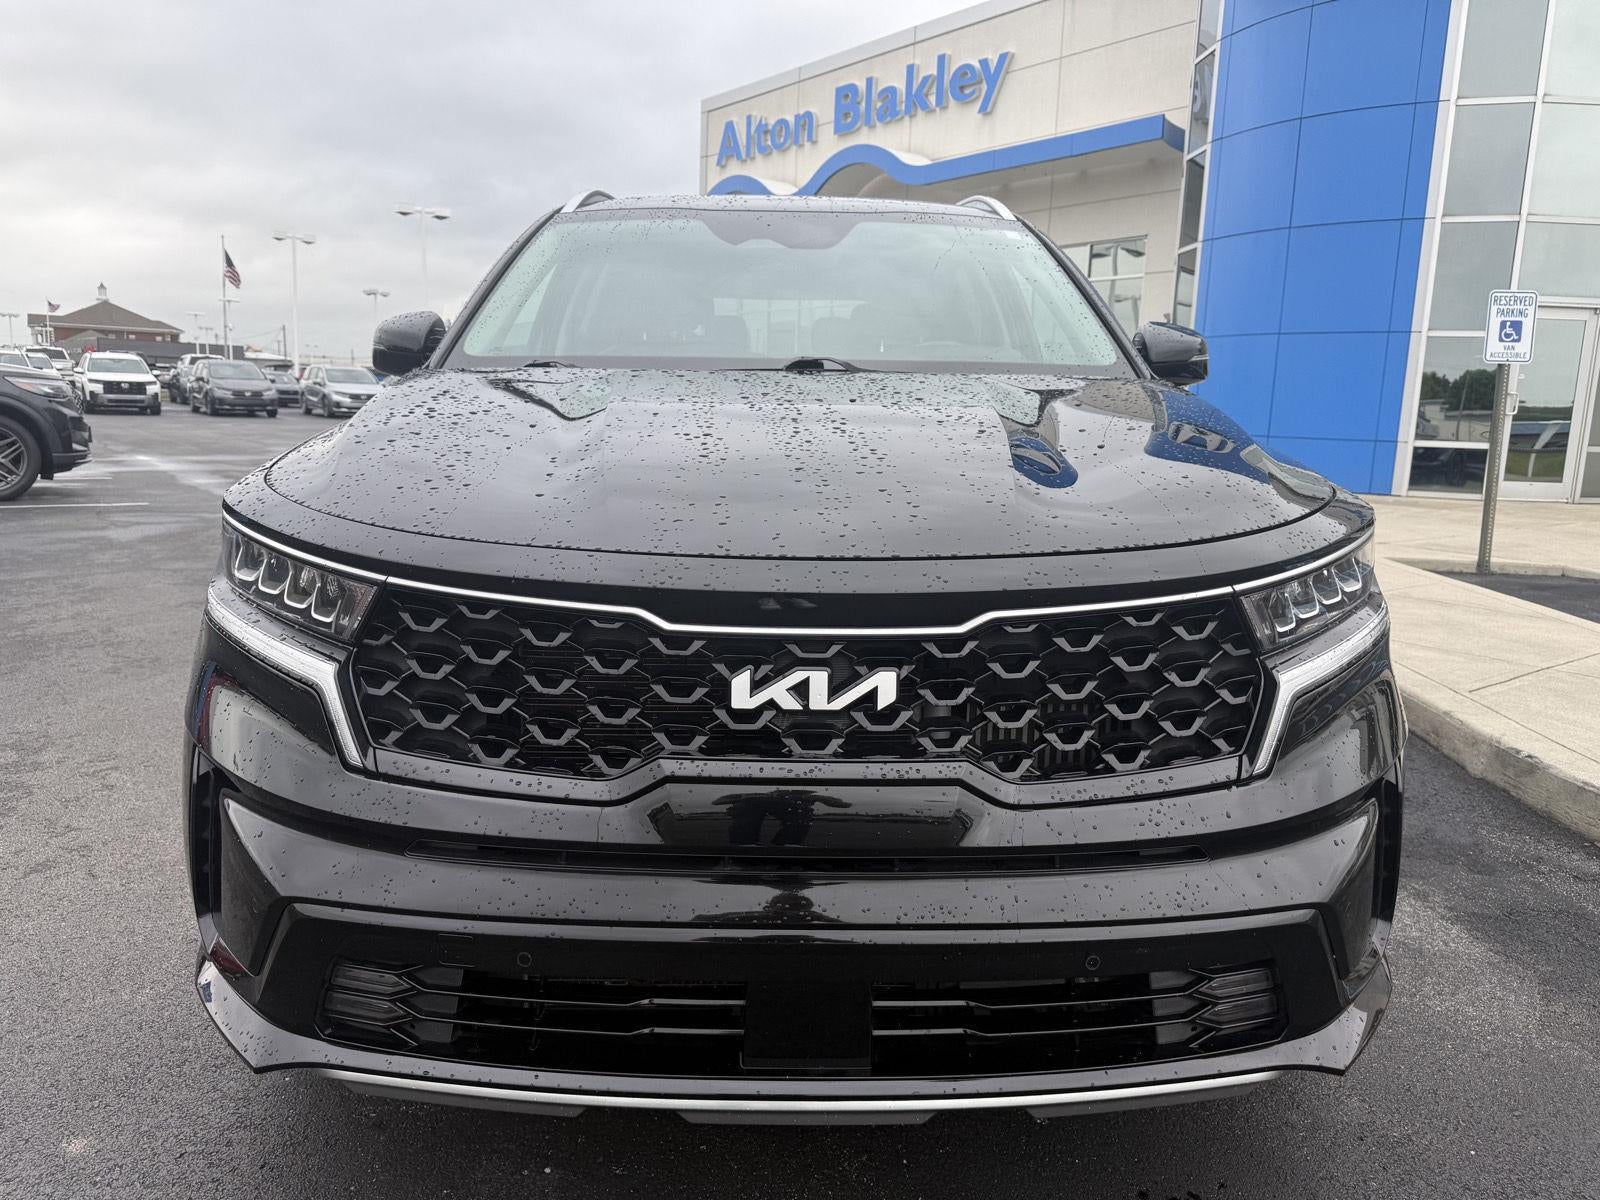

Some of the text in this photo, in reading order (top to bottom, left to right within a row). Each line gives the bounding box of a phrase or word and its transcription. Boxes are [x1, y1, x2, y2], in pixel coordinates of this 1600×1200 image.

[715, 51, 1015, 168] Alton Blakley
[1493, 295, 1534, 307] RESERVED
[1496, 307, 1528, 318] PARKING
